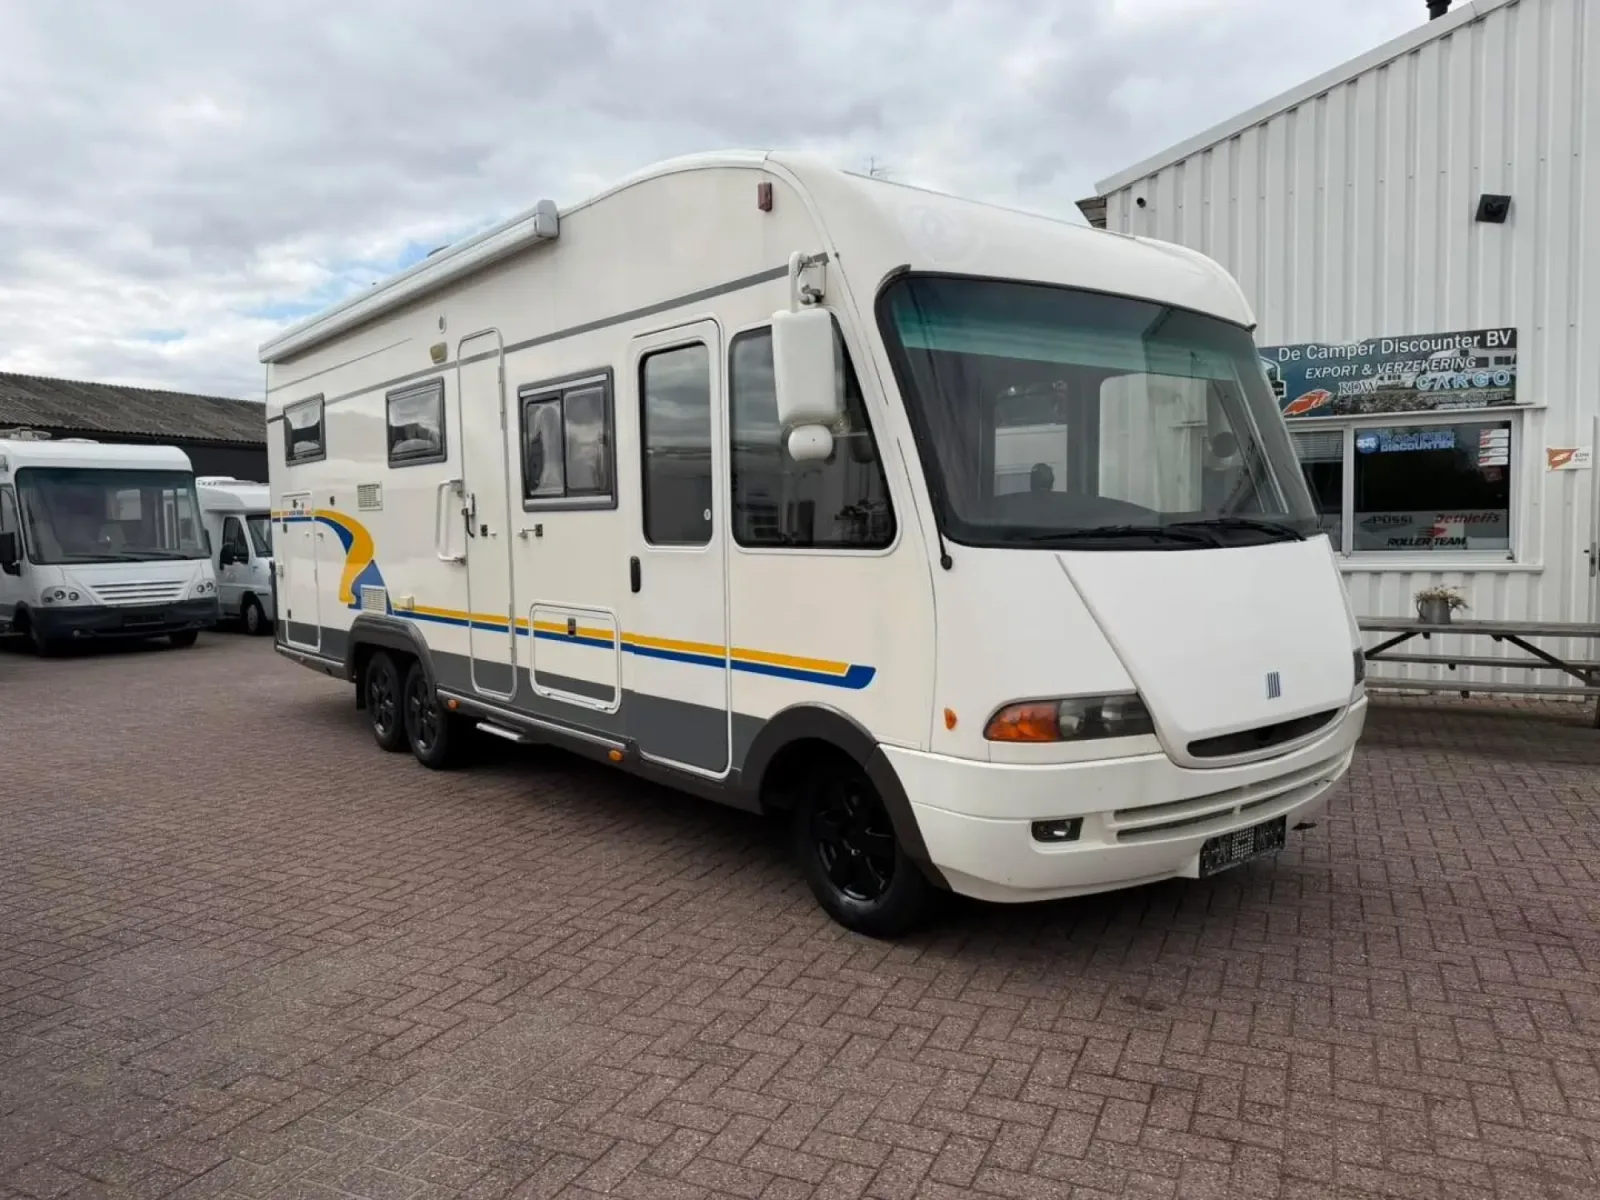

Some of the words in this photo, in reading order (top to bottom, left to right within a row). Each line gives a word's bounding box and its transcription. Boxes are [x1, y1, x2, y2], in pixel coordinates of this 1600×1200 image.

[1278, 347, 1301, 362] De
[1306, 343, 1376, 361] Camper
[1381, 333, 1480, 354] Discounter
[1486, 329, 1512, 347] BV
[1305, 364, 1359, 380] EXPORT
[1361, 363, 1373, 376] &
[1377, 355, 1477, 374] VERZEKERING
[1338, 378, 1380, 397] RDW
[1416, 369, 1511, 391] CARGO
[1388, 536, 1432, 546] ROLLER
[1434, 536, 1467, 546] TEAM
